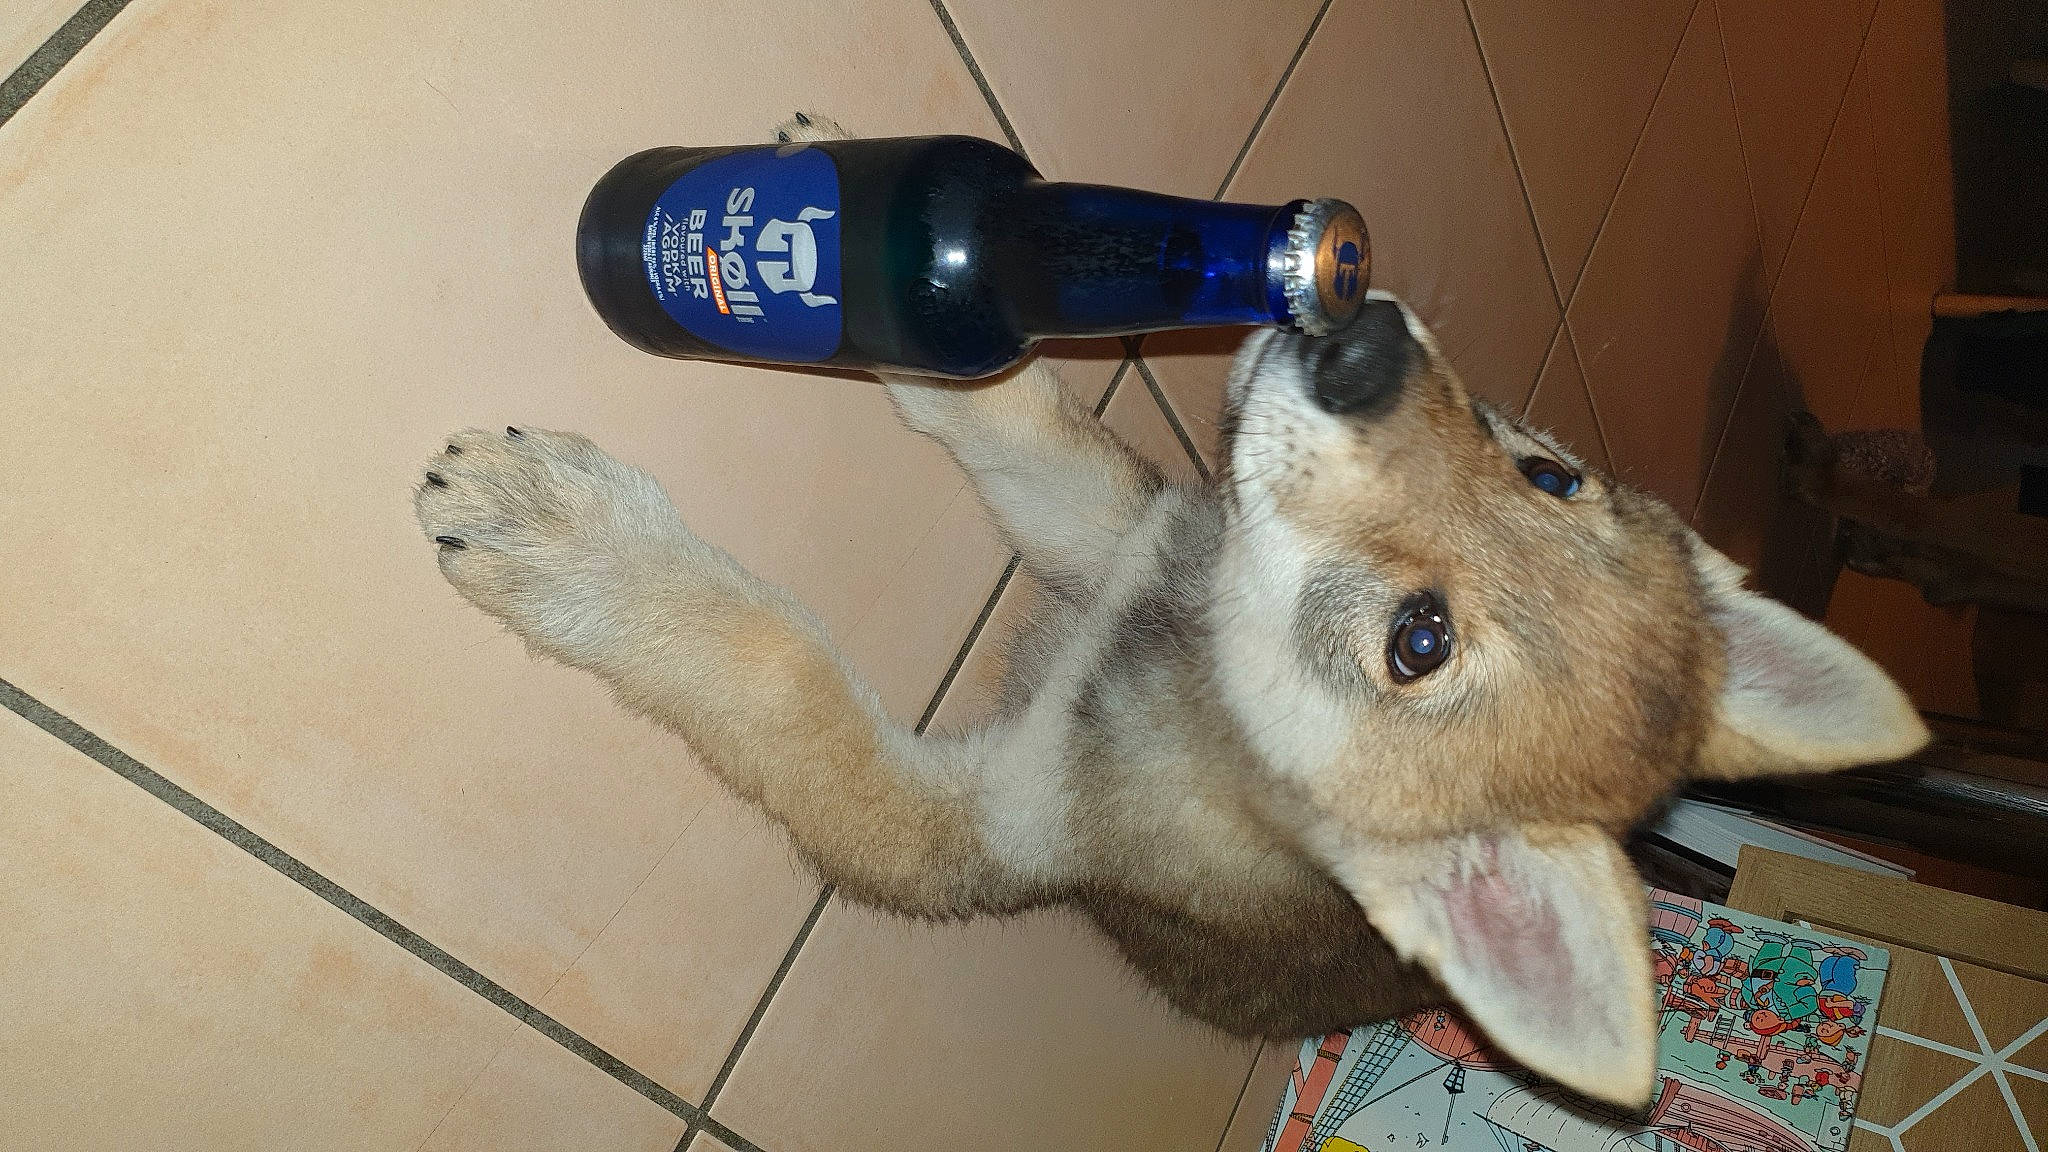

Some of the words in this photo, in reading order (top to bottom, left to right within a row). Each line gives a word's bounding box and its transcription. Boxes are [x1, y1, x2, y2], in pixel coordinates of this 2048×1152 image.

[670, 222, 683, 286] VODKA
[680, 217, 690, 267] flavoured
[687, 209, 709, 299] BEER
[681, 269, 691, 292] with
[708, 255, 727, 312] ORIGINAL
